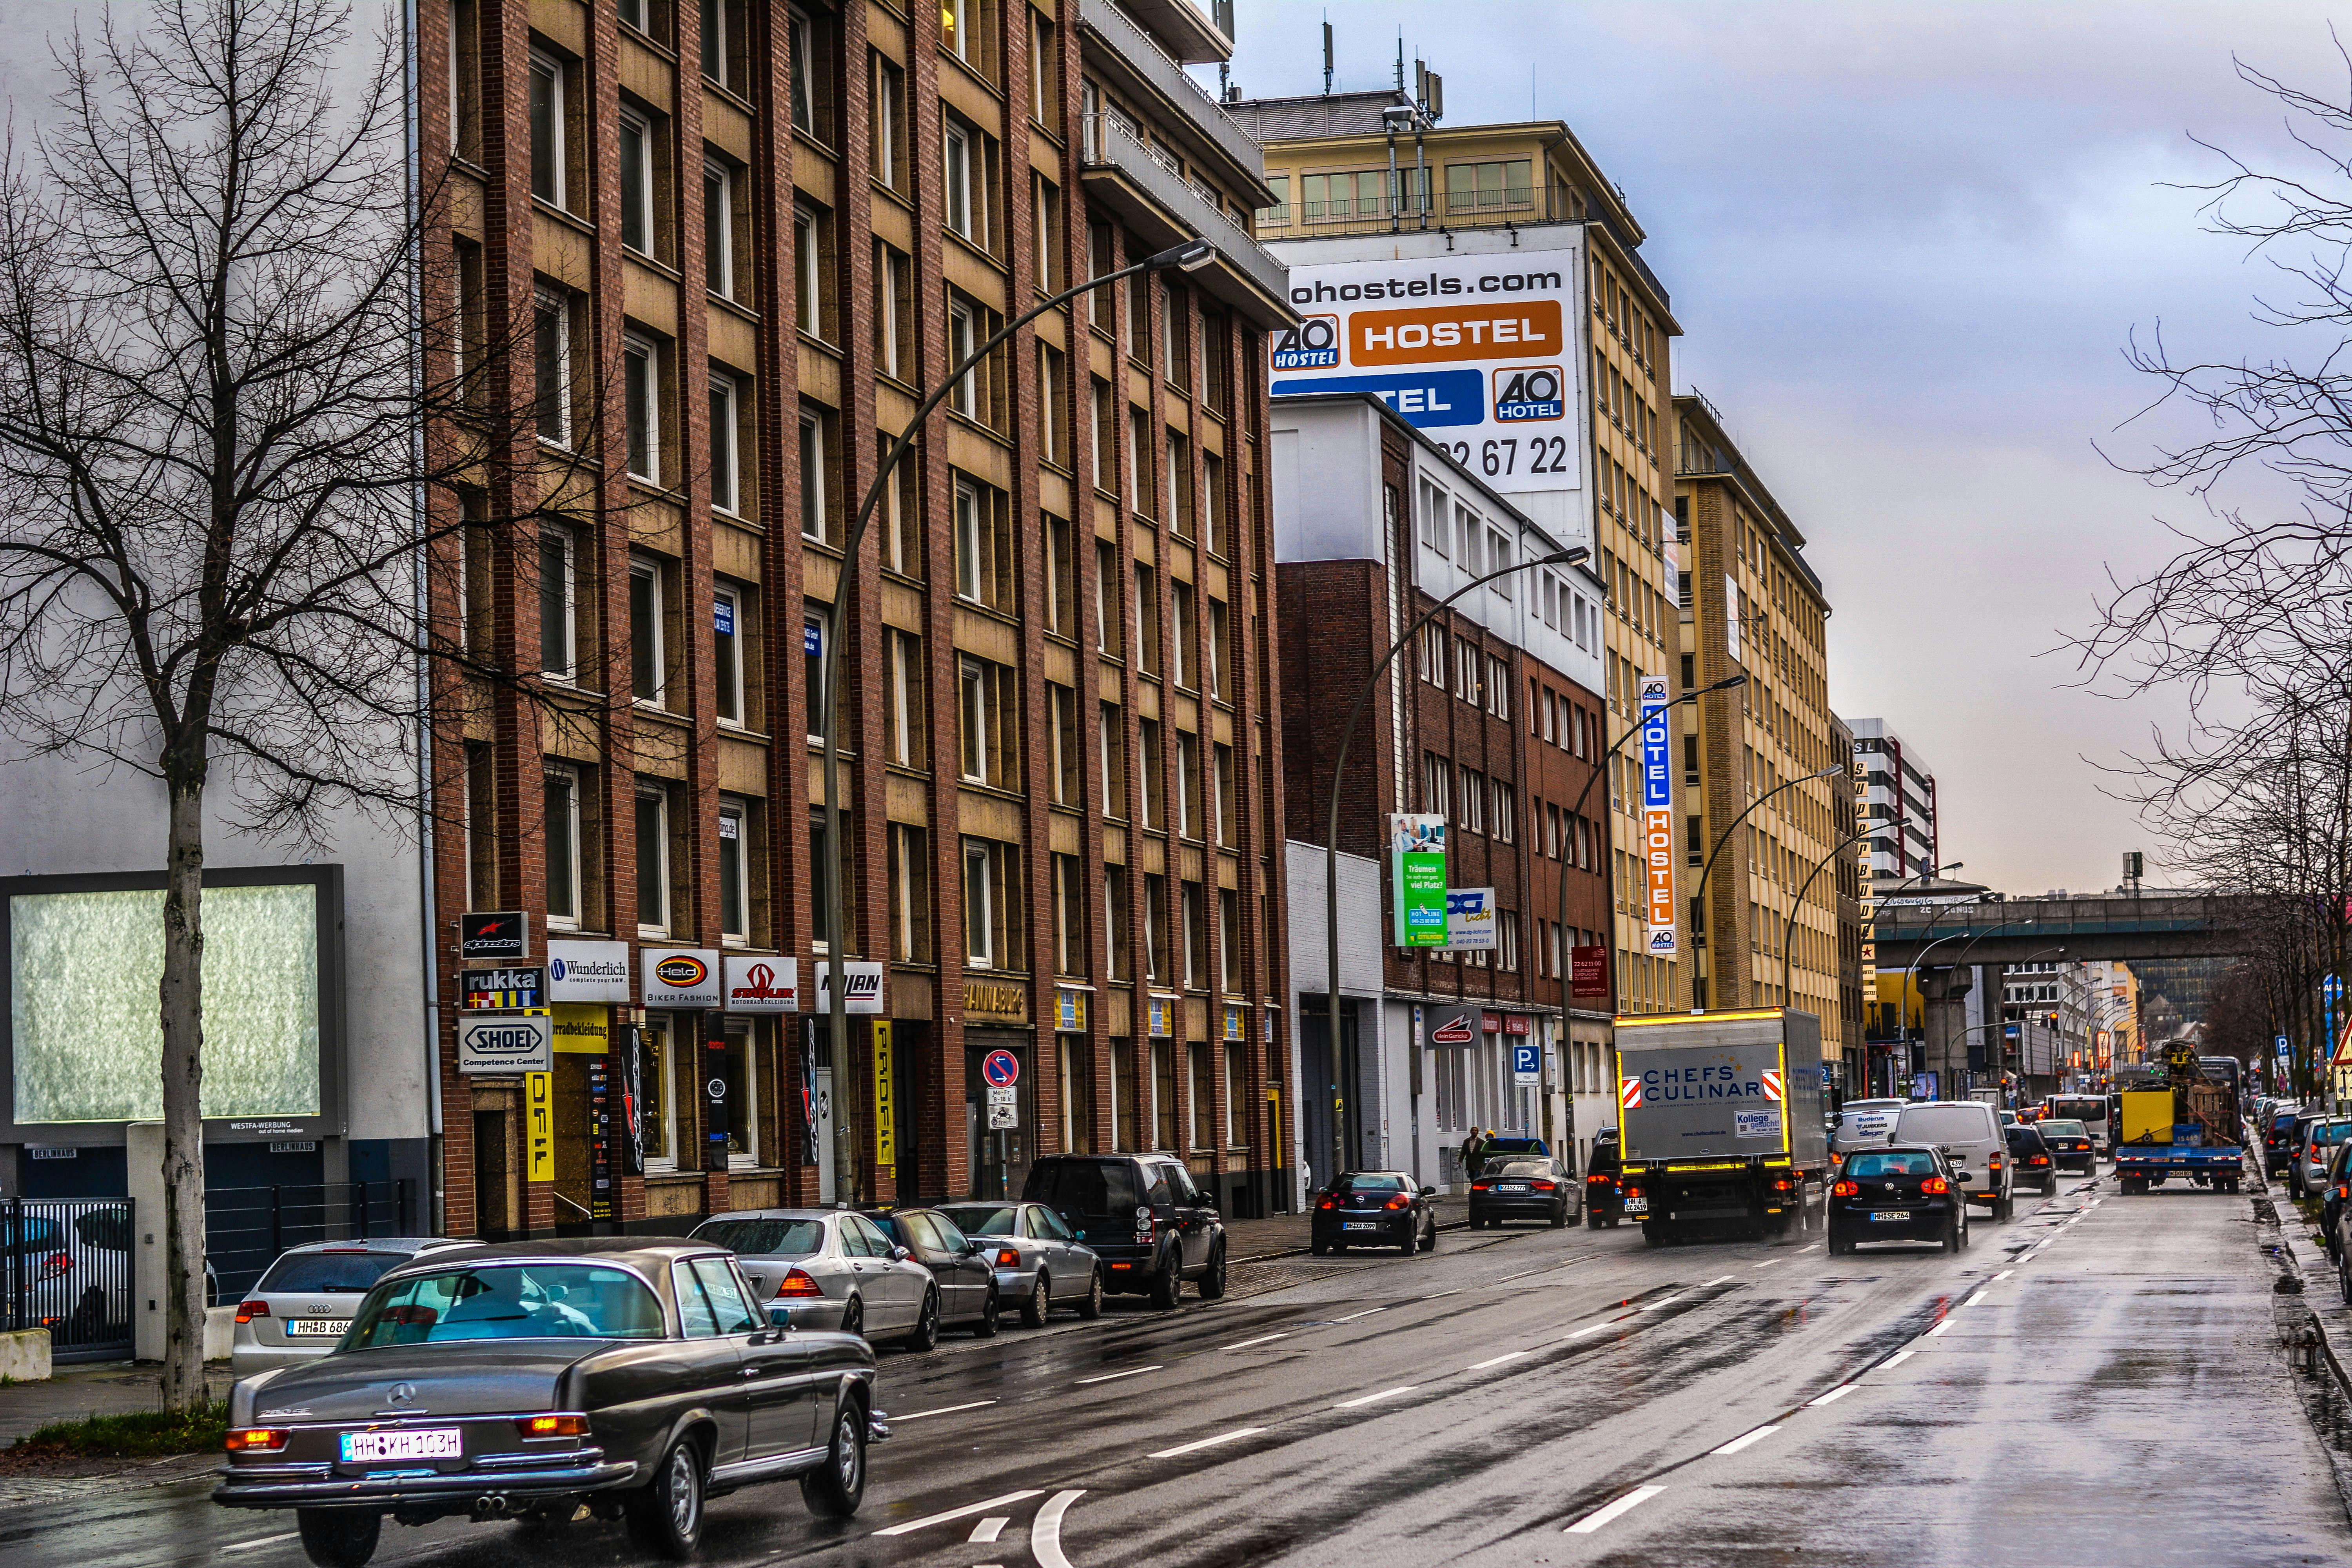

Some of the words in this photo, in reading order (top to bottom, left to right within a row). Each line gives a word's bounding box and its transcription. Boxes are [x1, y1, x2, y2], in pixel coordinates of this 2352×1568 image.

[1365, 318, 1545, 350] HOSTEL
[1275, 351, 1336, 368] HOSTEL
[1499, 404, 1560, 418] HOTEL
[1483, 439, 1517, 476] 67
[1530, 436, 1567, 474] 22
[1646, 710, 1666, 799] HOTEL
[1649, 814, 1670, 922] HOSTEL
[1465, 907, 1492, 922] Licht
[464, 939, 521, 949] alpinestars
[566, 961, 626, 975] Wunderlich
[658, 967, 696, 976] Held
[469, 971, 536, 990] rukka
[820, 975, 881, 997] NLAN
[731, 987, 795, 998] STADLER
[477, 1030, 531, 1049] SHOEI
[2279, 1038, 2287, 1053] P
[1518, 1049, 1532, 1069] P
[1644, 1066, 1733, 1084] CHEFS
[1645, 1082, 1760, 1101] CULINAR
[1737, 1114, 1769, 1124] Kollege
[1751, 1120, 1779, 1129] gesucht!
[34, 1149, 74, 1158] BERLINHAUS
[271, 1142, 314, 1152] BERLINHAUS
[298, 1322, 313, 1333] HH
[319, 1322, 326, 1332] B
[329, 1322, 349, 1333] 686
[355, 1437, 375, 1456] HH
[389, 1436, 409, 1454] KH
